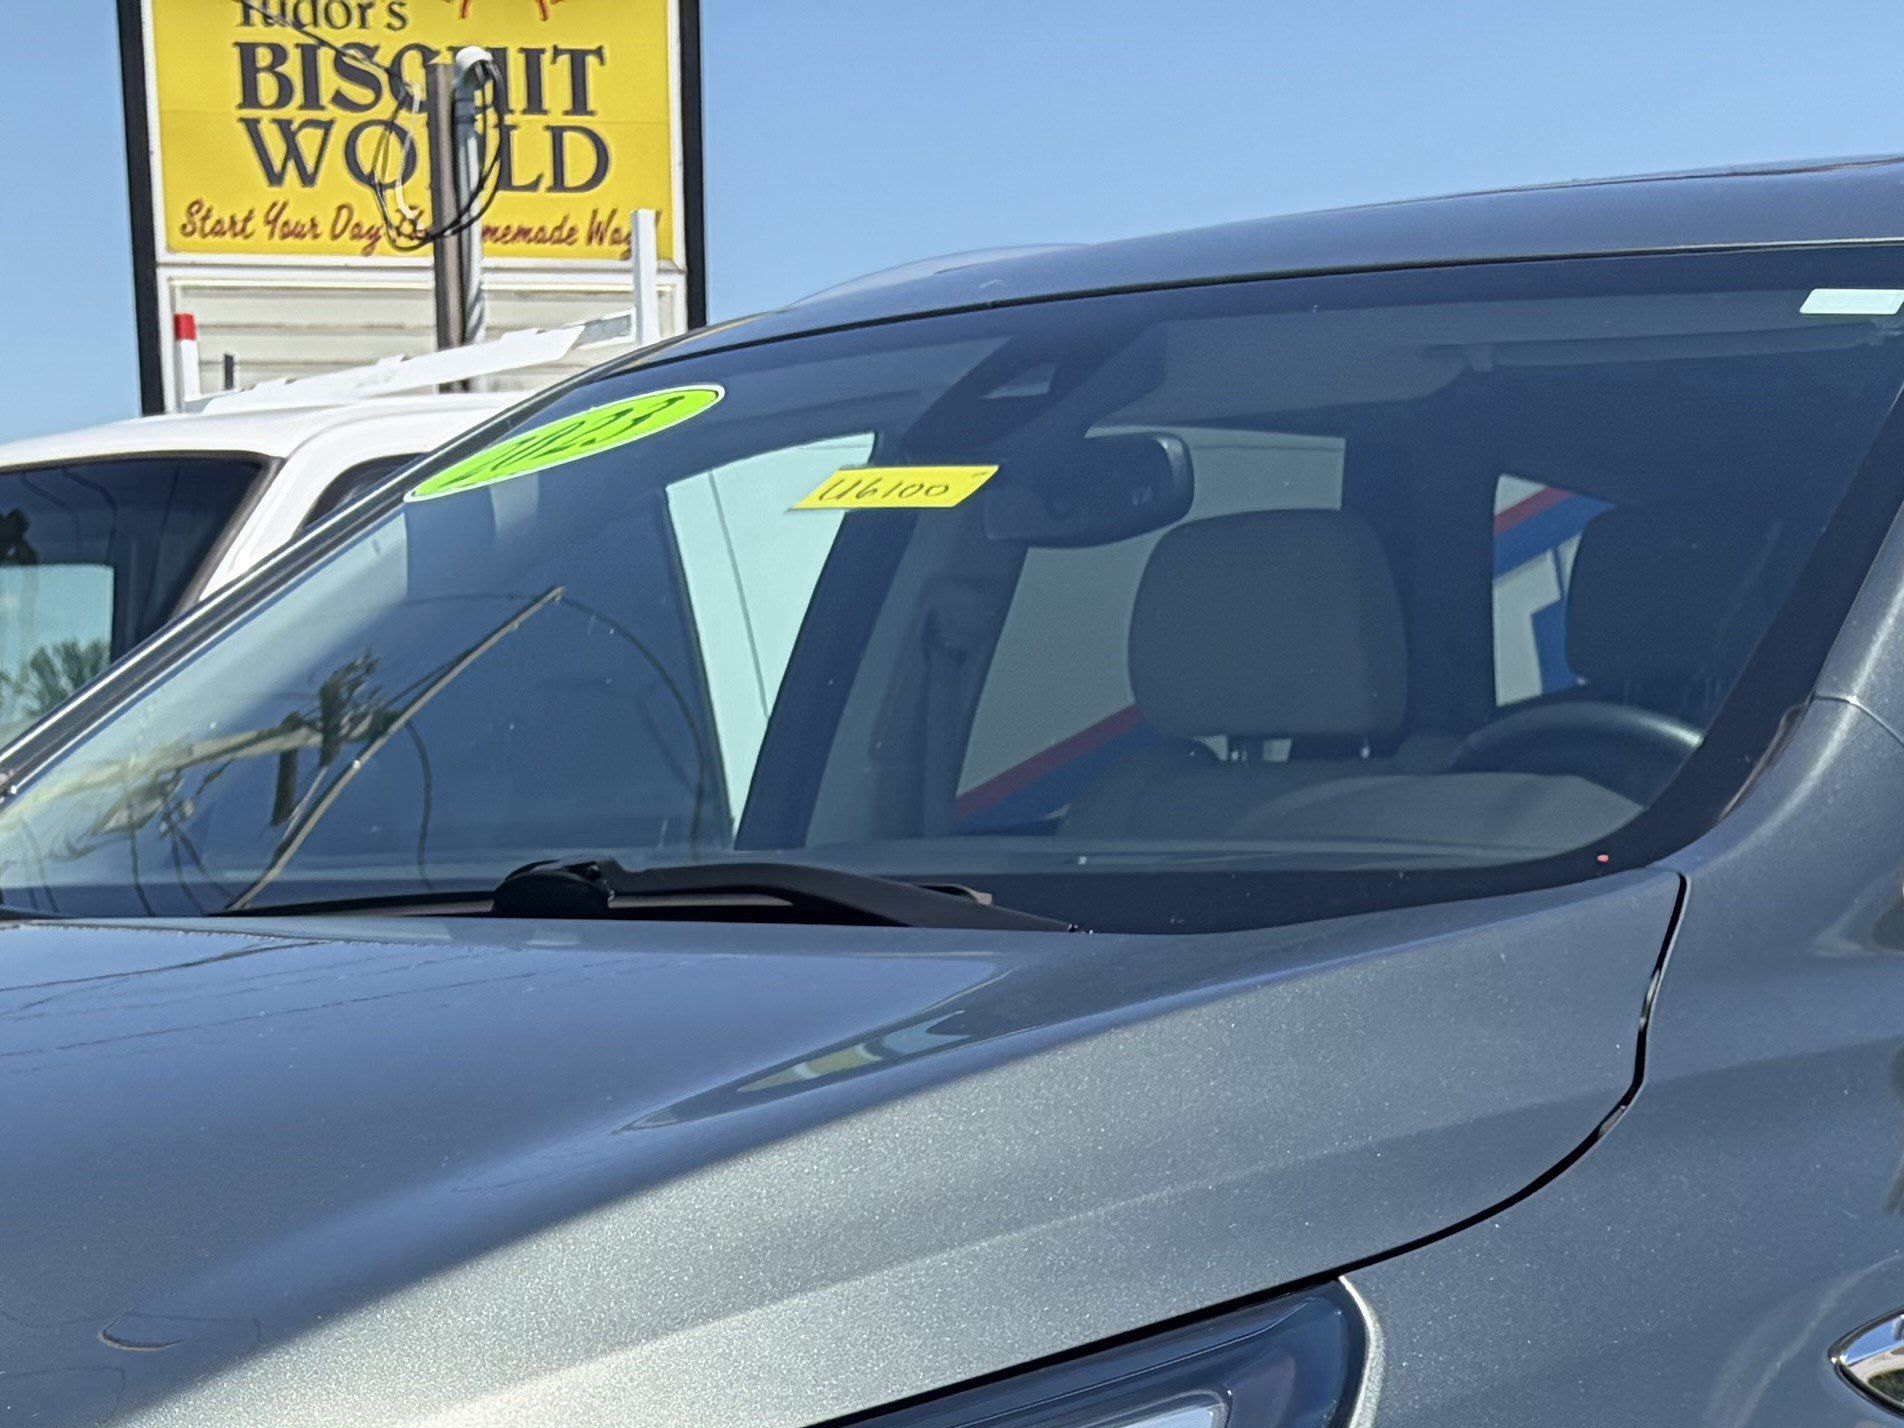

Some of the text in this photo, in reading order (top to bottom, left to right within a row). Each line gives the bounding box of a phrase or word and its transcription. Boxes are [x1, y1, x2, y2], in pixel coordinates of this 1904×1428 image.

[234, 0, 409, 31] Tudors
[237, 117, 610, 193] WOLD
[179, 197, 256, 240] Start
[263, 199, 324, 242] Your
[329, 202, 386, 257] Day
[481, 213, 579, 247] memade
[434, 394, 686, 488] 2023
